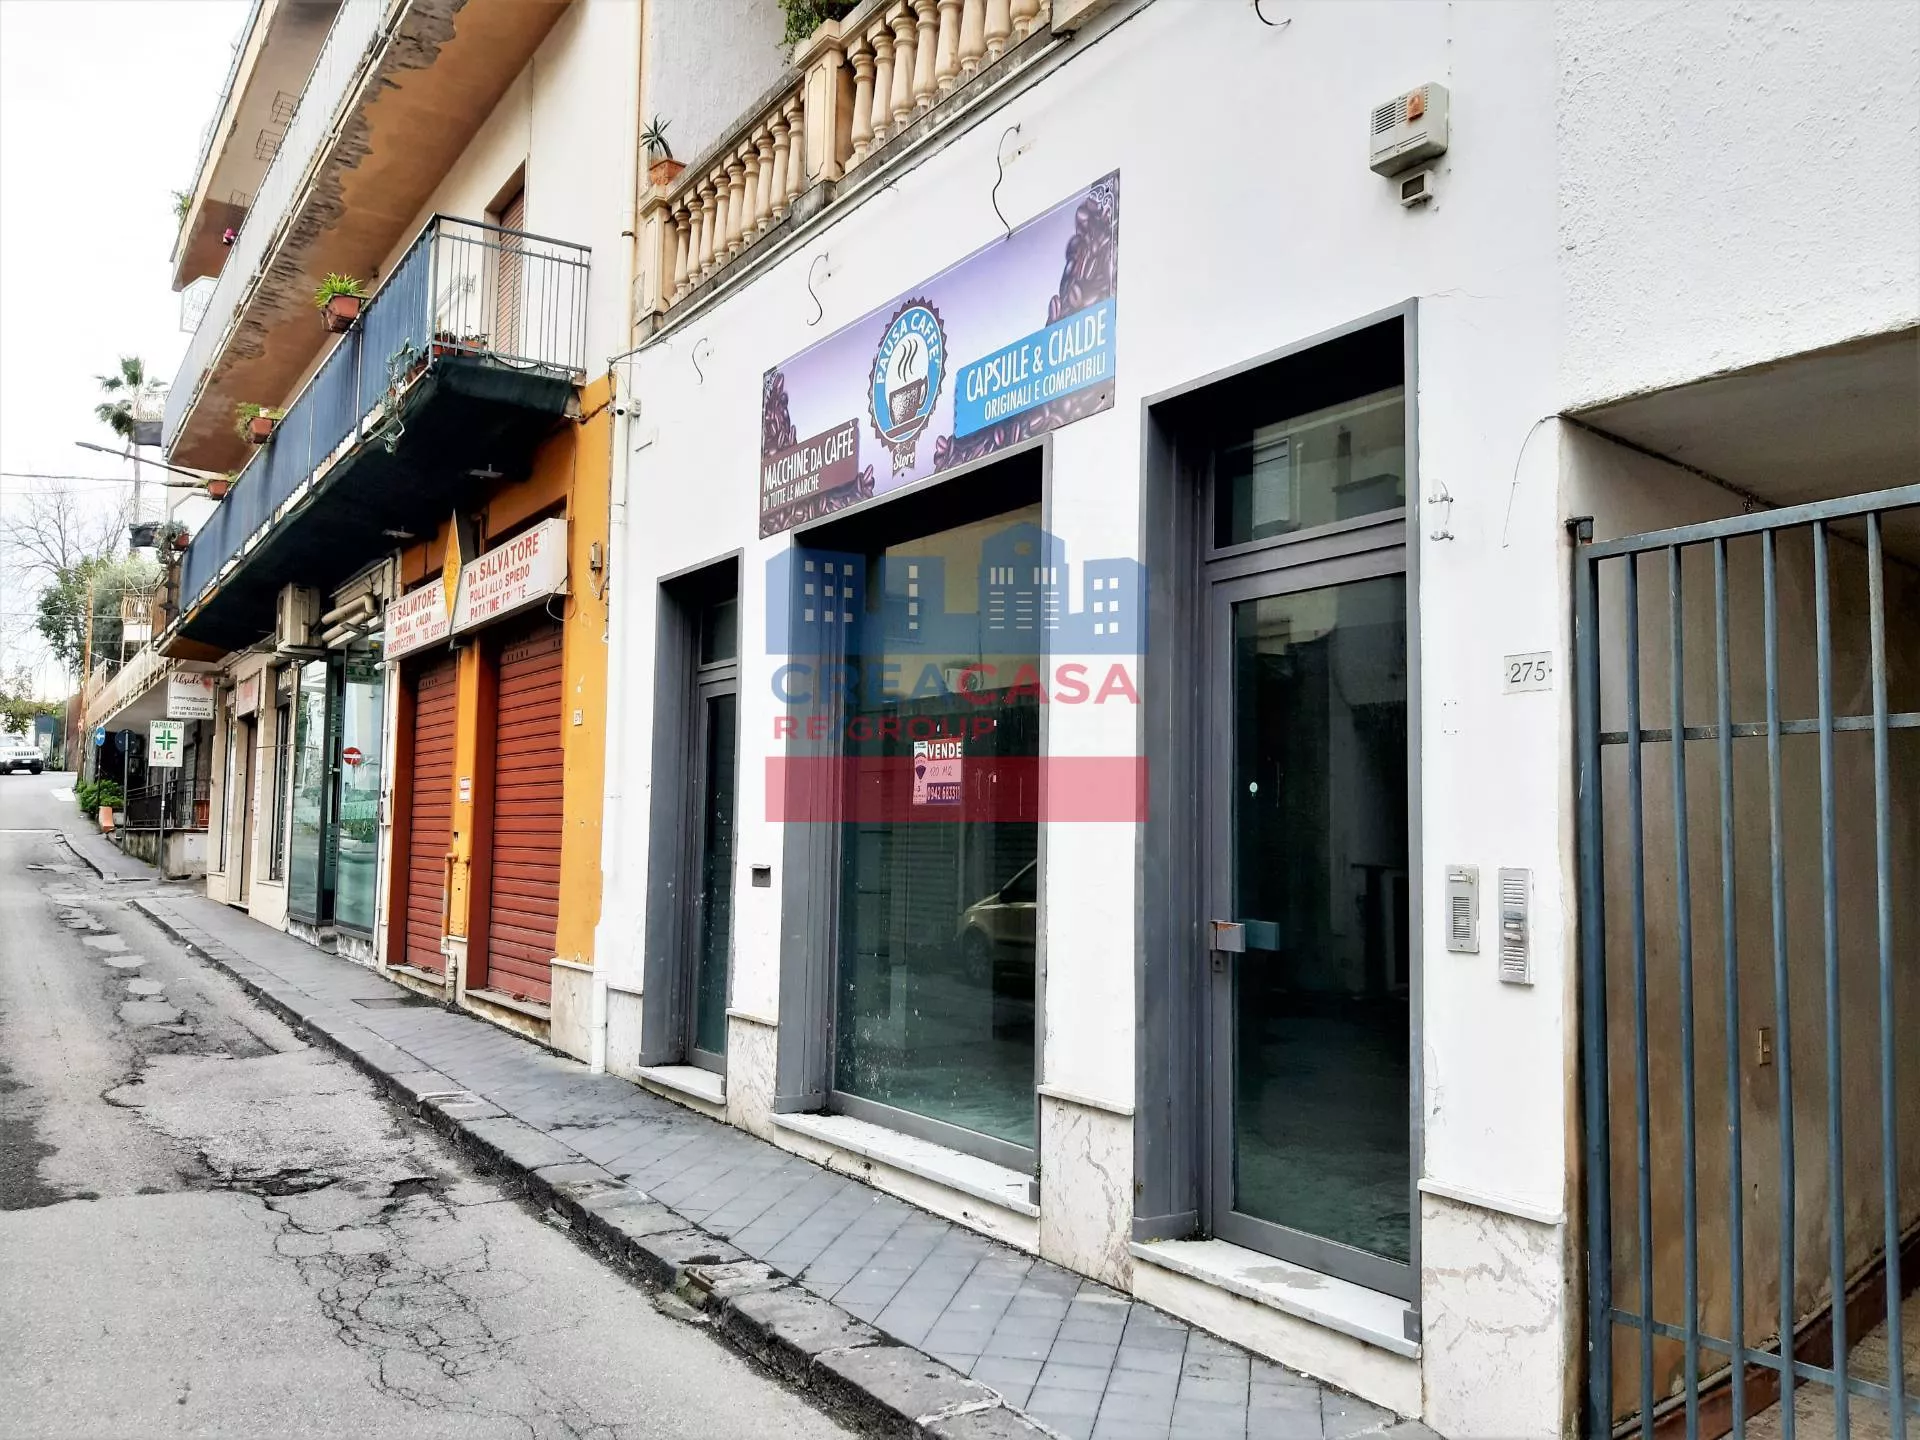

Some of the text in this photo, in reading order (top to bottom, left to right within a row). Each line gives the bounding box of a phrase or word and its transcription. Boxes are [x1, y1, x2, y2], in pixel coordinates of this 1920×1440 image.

[875, 318, 908, 384] PAUSA
[966, 308, 1108, 403] CAPSULE & CIALDE
[984, 352, 1106, 421] ORIGINALI E COMPATIBILI
[763, 420, 855, 493] MACCHINE DA CAFFÈ
[893, 451, 915, 471] Store
[770, 487, 786, 509] TUTTE
[787, 483, 794, 502] LE
[794, 473, 820, 499] MARCHE
[468, 532, 539, 588] DA SALVATORE
[470, 563, 530, 605] POLLI ALLO SPIEDO
[398, 587, 437, 621] SALVATORE
[470, 596, 500, 621] PATATINE
[1510, 660, 1546, 684] 275
[151, 721, 183, 730] FARMACIA
[928, 742, 962, 760] VENDE
